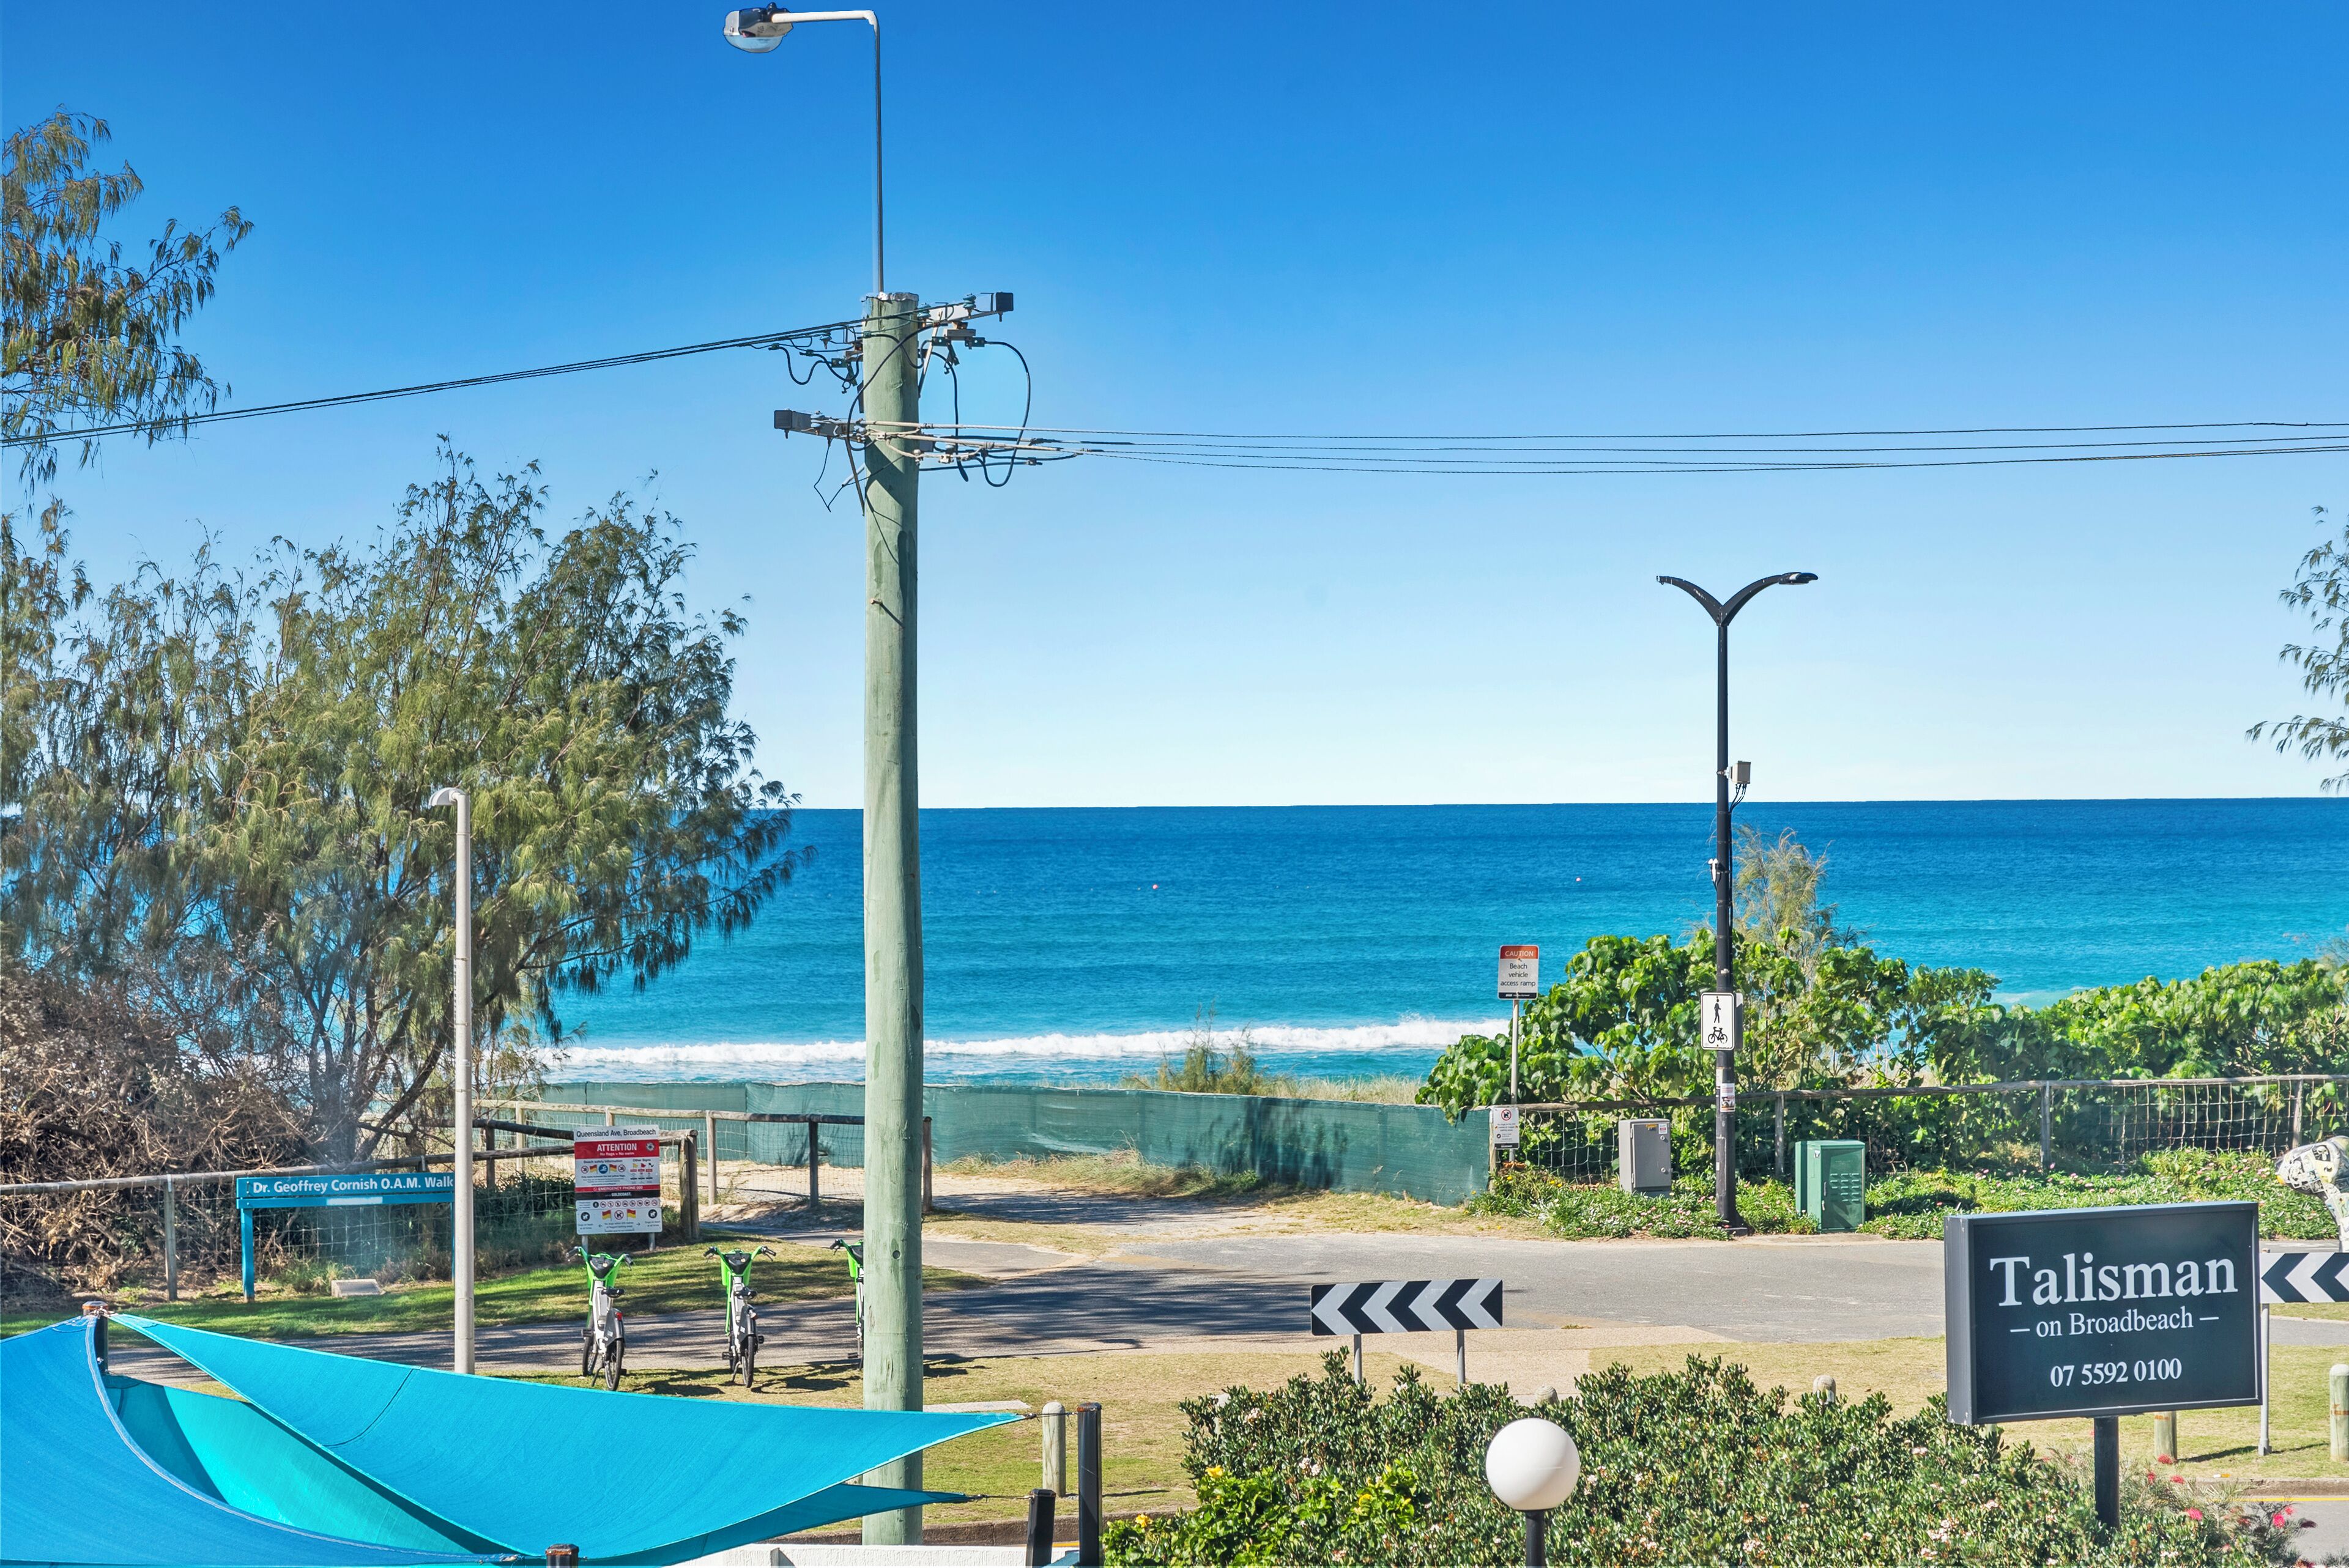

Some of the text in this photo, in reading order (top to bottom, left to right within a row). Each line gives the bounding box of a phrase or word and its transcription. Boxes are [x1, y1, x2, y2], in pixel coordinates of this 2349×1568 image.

[597, 1143, 637, 1152] ATTENTION
[253, 1175, 454, 1194] Dr. Geoffrey Cornish O.A.M. Walk
[1989, 1252, 2238, 1307] Talisman
[2035, 1305, 2194, 1338] on Broadbeach
[2050, 1357, 2183, 1388] 07 5592 0100
